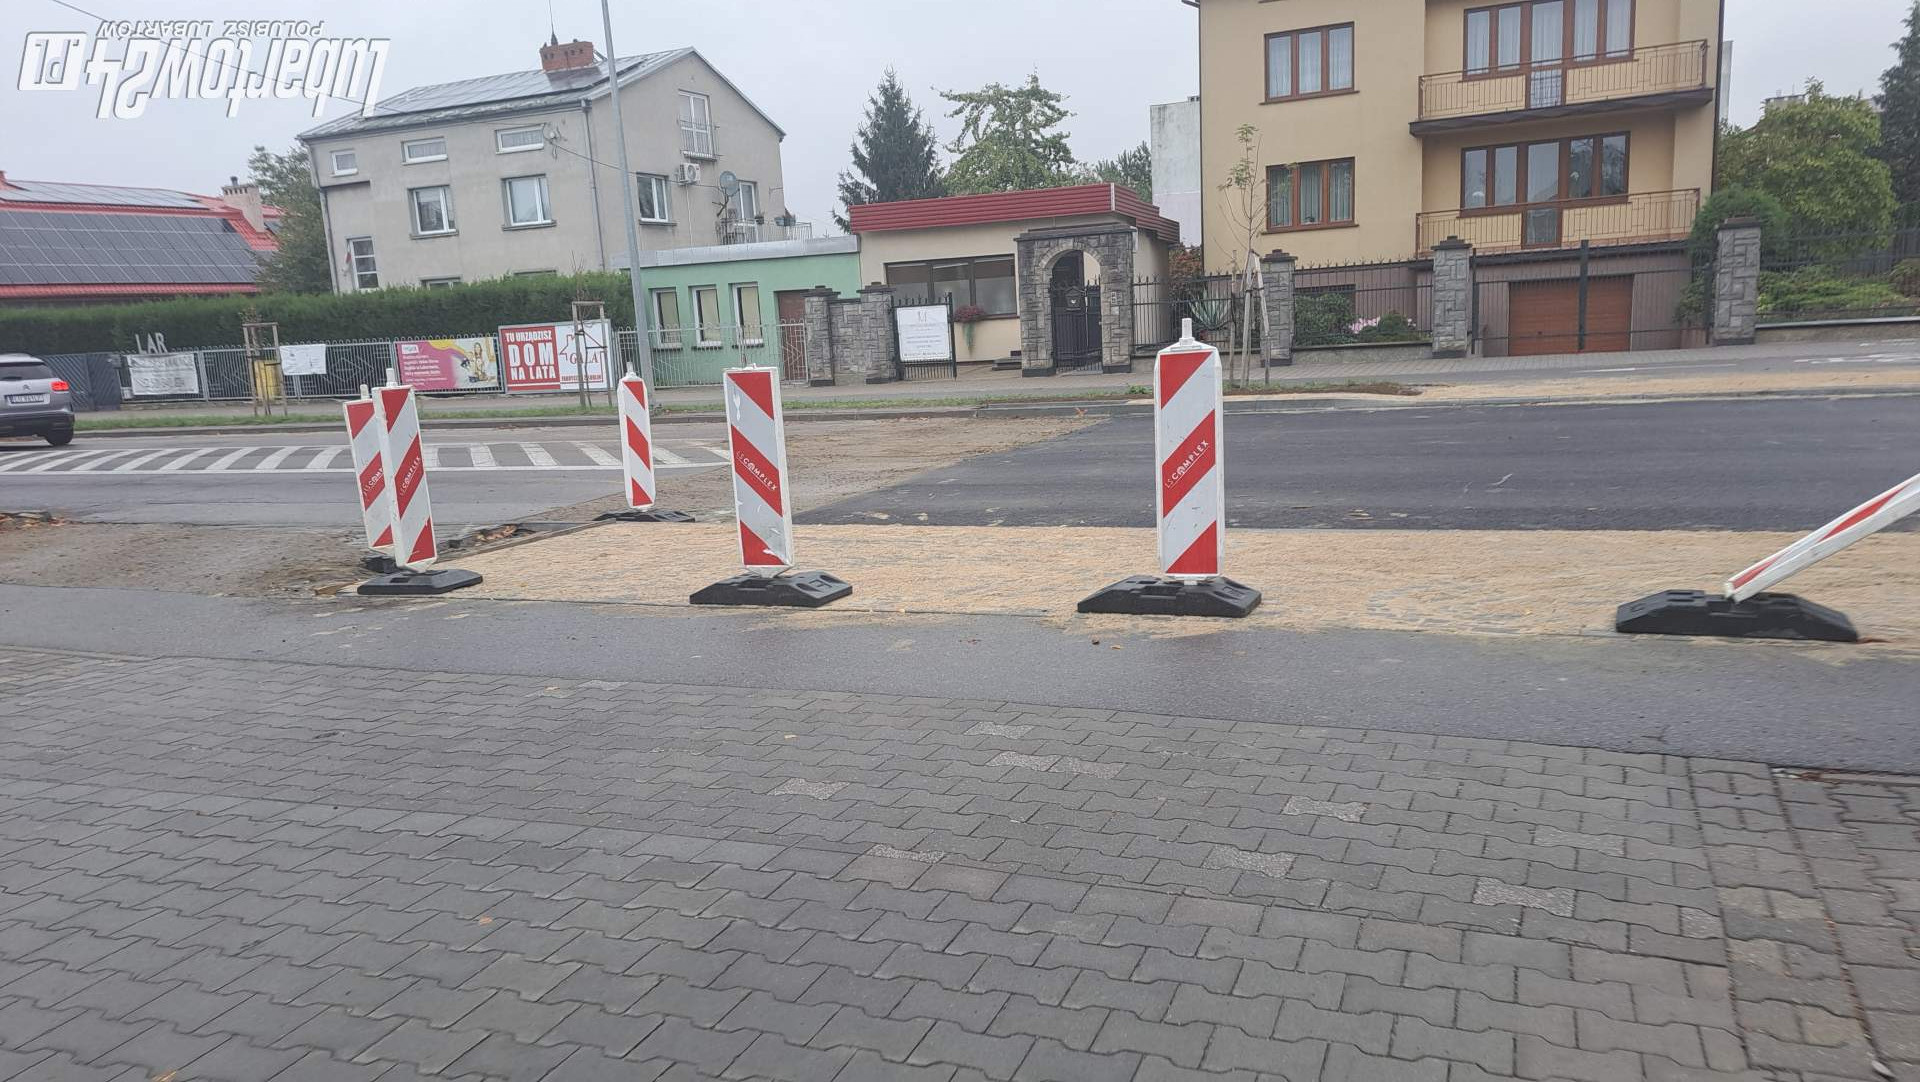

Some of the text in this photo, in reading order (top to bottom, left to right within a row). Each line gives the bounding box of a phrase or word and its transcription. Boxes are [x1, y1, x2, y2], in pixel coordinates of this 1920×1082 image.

[135, 332, 168, 354] LAR
[505, 332, 515, 343] TU
[508, 342, 555, 367] DOM
[511, 365, 556, 380] NA LATA
[1171, 439, 1209, 480] COMPLEX
[368, 467, 384, 486] COMP
[743, 457, 777, 491] COMPLEX
